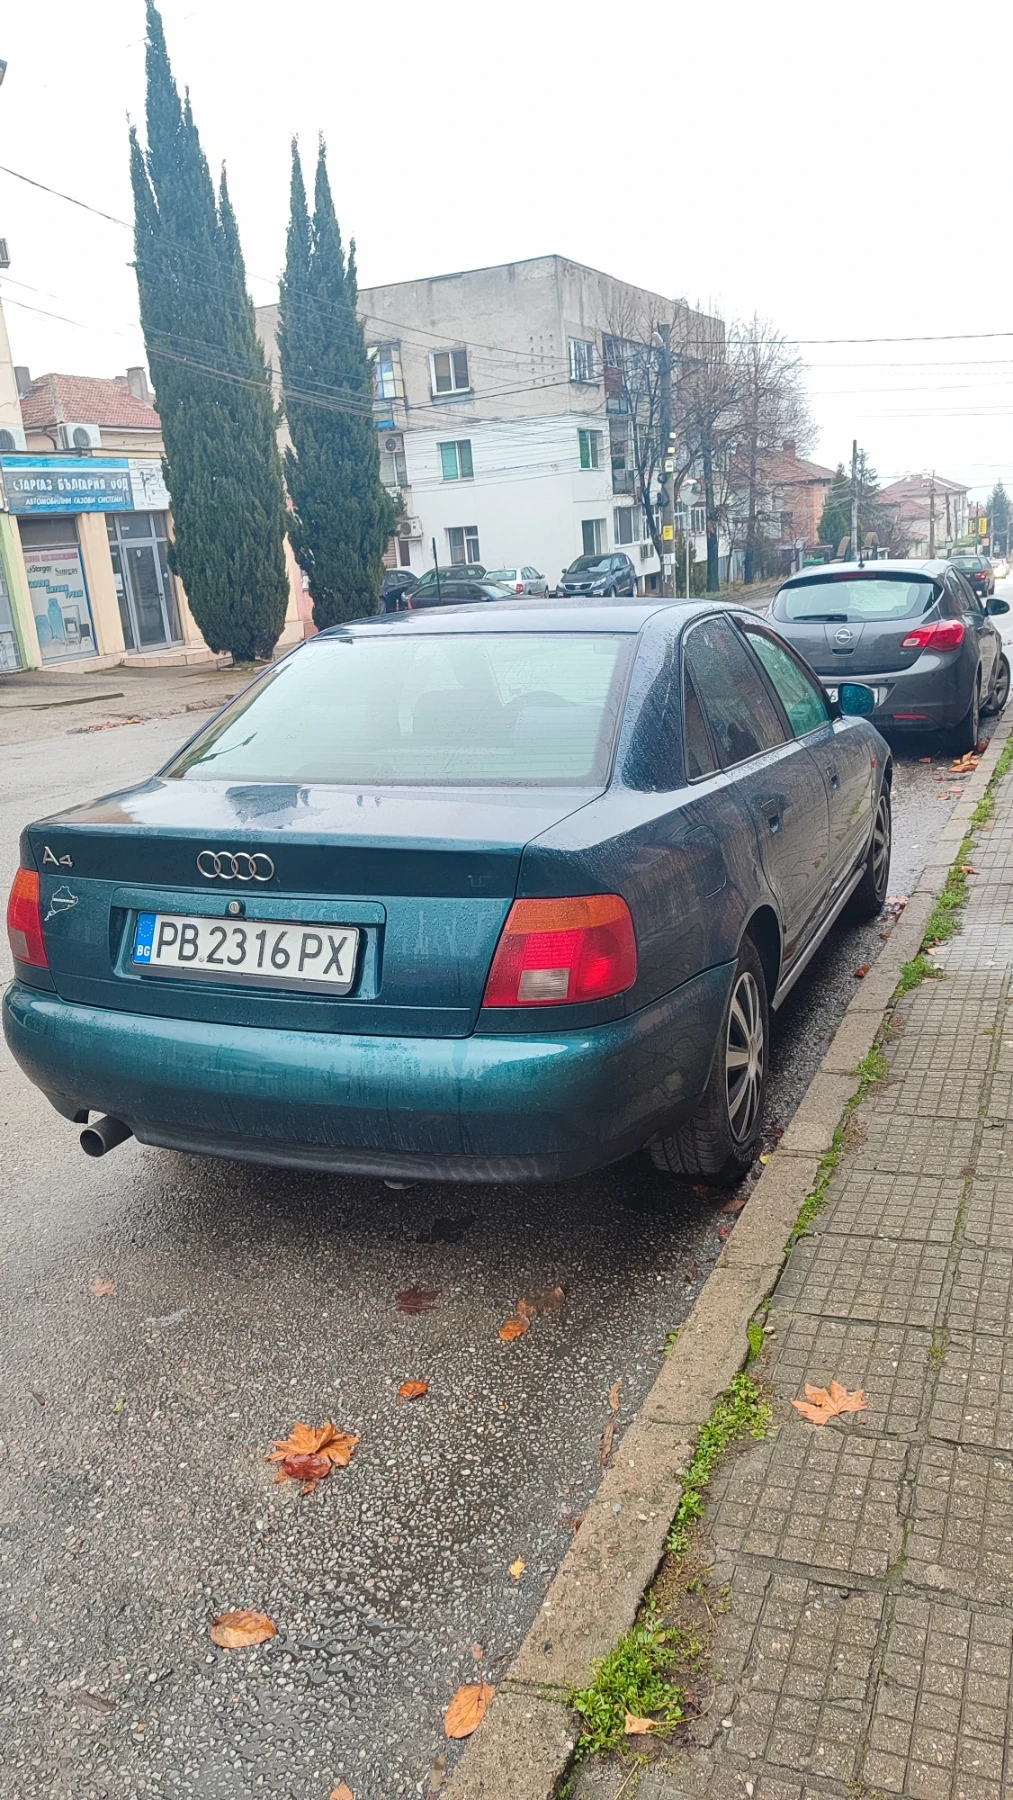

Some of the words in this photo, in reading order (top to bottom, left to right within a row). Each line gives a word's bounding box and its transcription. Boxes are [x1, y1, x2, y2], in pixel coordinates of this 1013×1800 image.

[58, 478, 106, 490] БЪЛГАРИЯ
[25, 497, 72, 506] АВТОМОБИЛНИ
[74, 496, 96, 504] ГАЗОВИ
[97, 496, 123, 504] СИСТЕМИ
[43, 846, 74, 868] A4
[136, 945, 150, 956] BG
